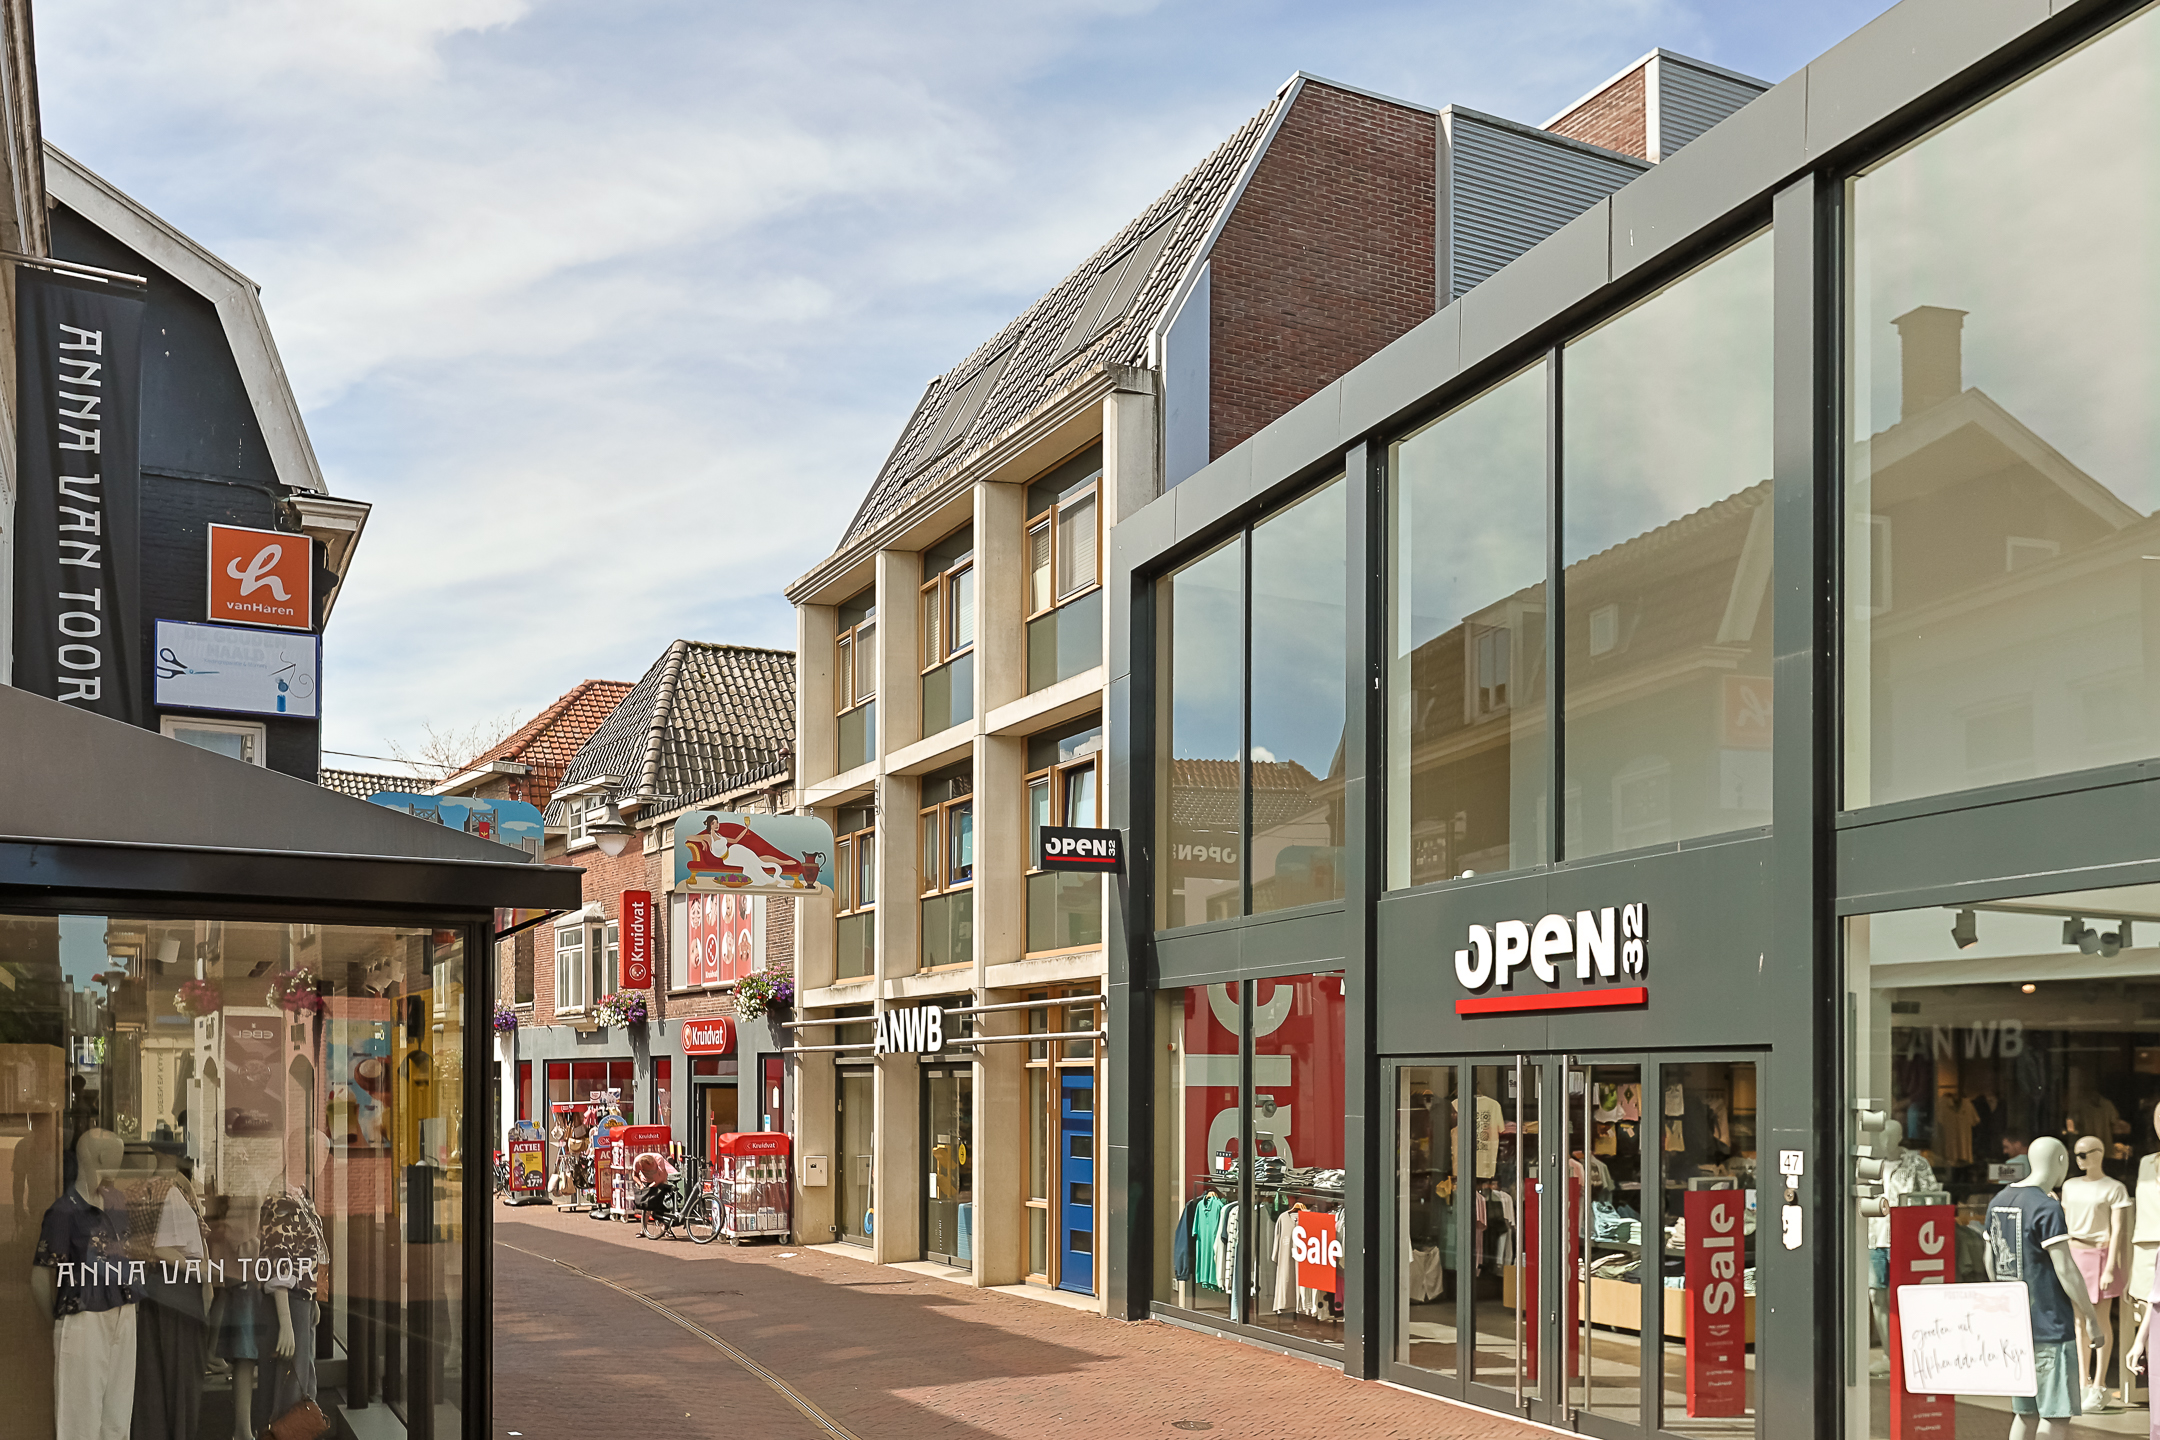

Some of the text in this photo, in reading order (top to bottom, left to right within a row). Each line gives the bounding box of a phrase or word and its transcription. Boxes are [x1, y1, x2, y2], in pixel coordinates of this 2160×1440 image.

[57, 323, 102, 702] ANNA VAN TOOR
[226, 601, 294, 616] vanHaren
[630, 901, 645, 963] Kruidvat
[691, 1023, 724, 1047] Kruidvat
[874, 1005, 943, 1054] ANWB
[513, 1143, 541, 1152] ACTIE!
[1783, 1154, 1800, 1171] 47
[1292, 1226, 1343, 1268] Sale
[1703, 1203, 1736, 1315] Sale
[1911, 1220, 1946, 1283] le
[56, 1256, 315, 1288] ANNA VAN TOOR
